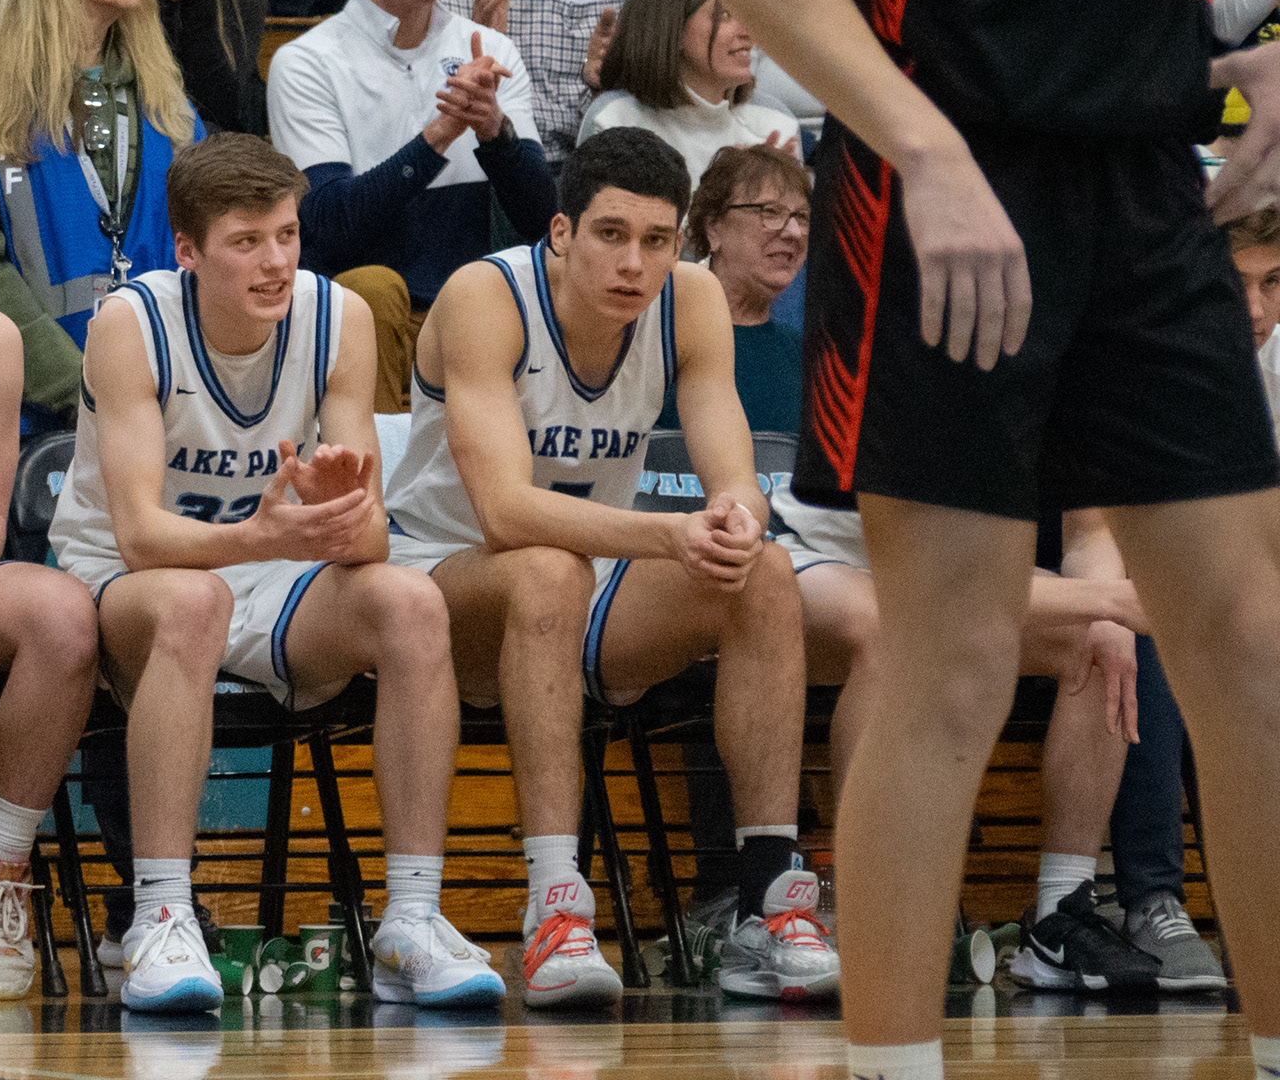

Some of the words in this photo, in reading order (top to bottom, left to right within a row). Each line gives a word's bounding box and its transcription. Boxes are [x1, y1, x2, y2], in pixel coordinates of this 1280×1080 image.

[528, 425, 582, 459] AKE
[589, 428, 647, 459] PAR
[168, 446, 238, 478] AKE
